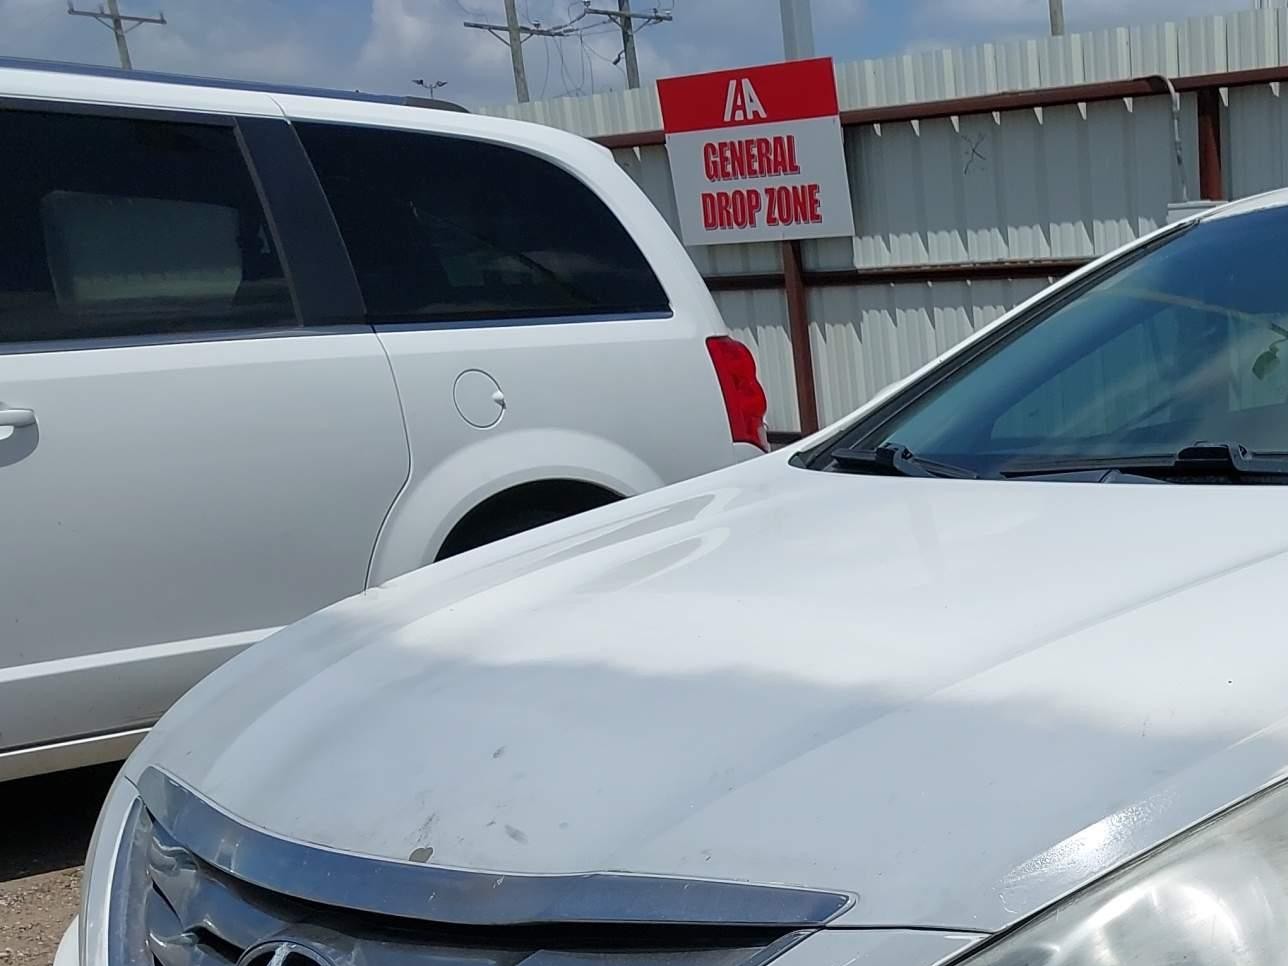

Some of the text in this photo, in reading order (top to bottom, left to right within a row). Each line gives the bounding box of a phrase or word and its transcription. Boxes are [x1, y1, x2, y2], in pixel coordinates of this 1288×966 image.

[703, 135, 800, 182] GENERAL
[702, 184, 823, 231] DROP ZONE
